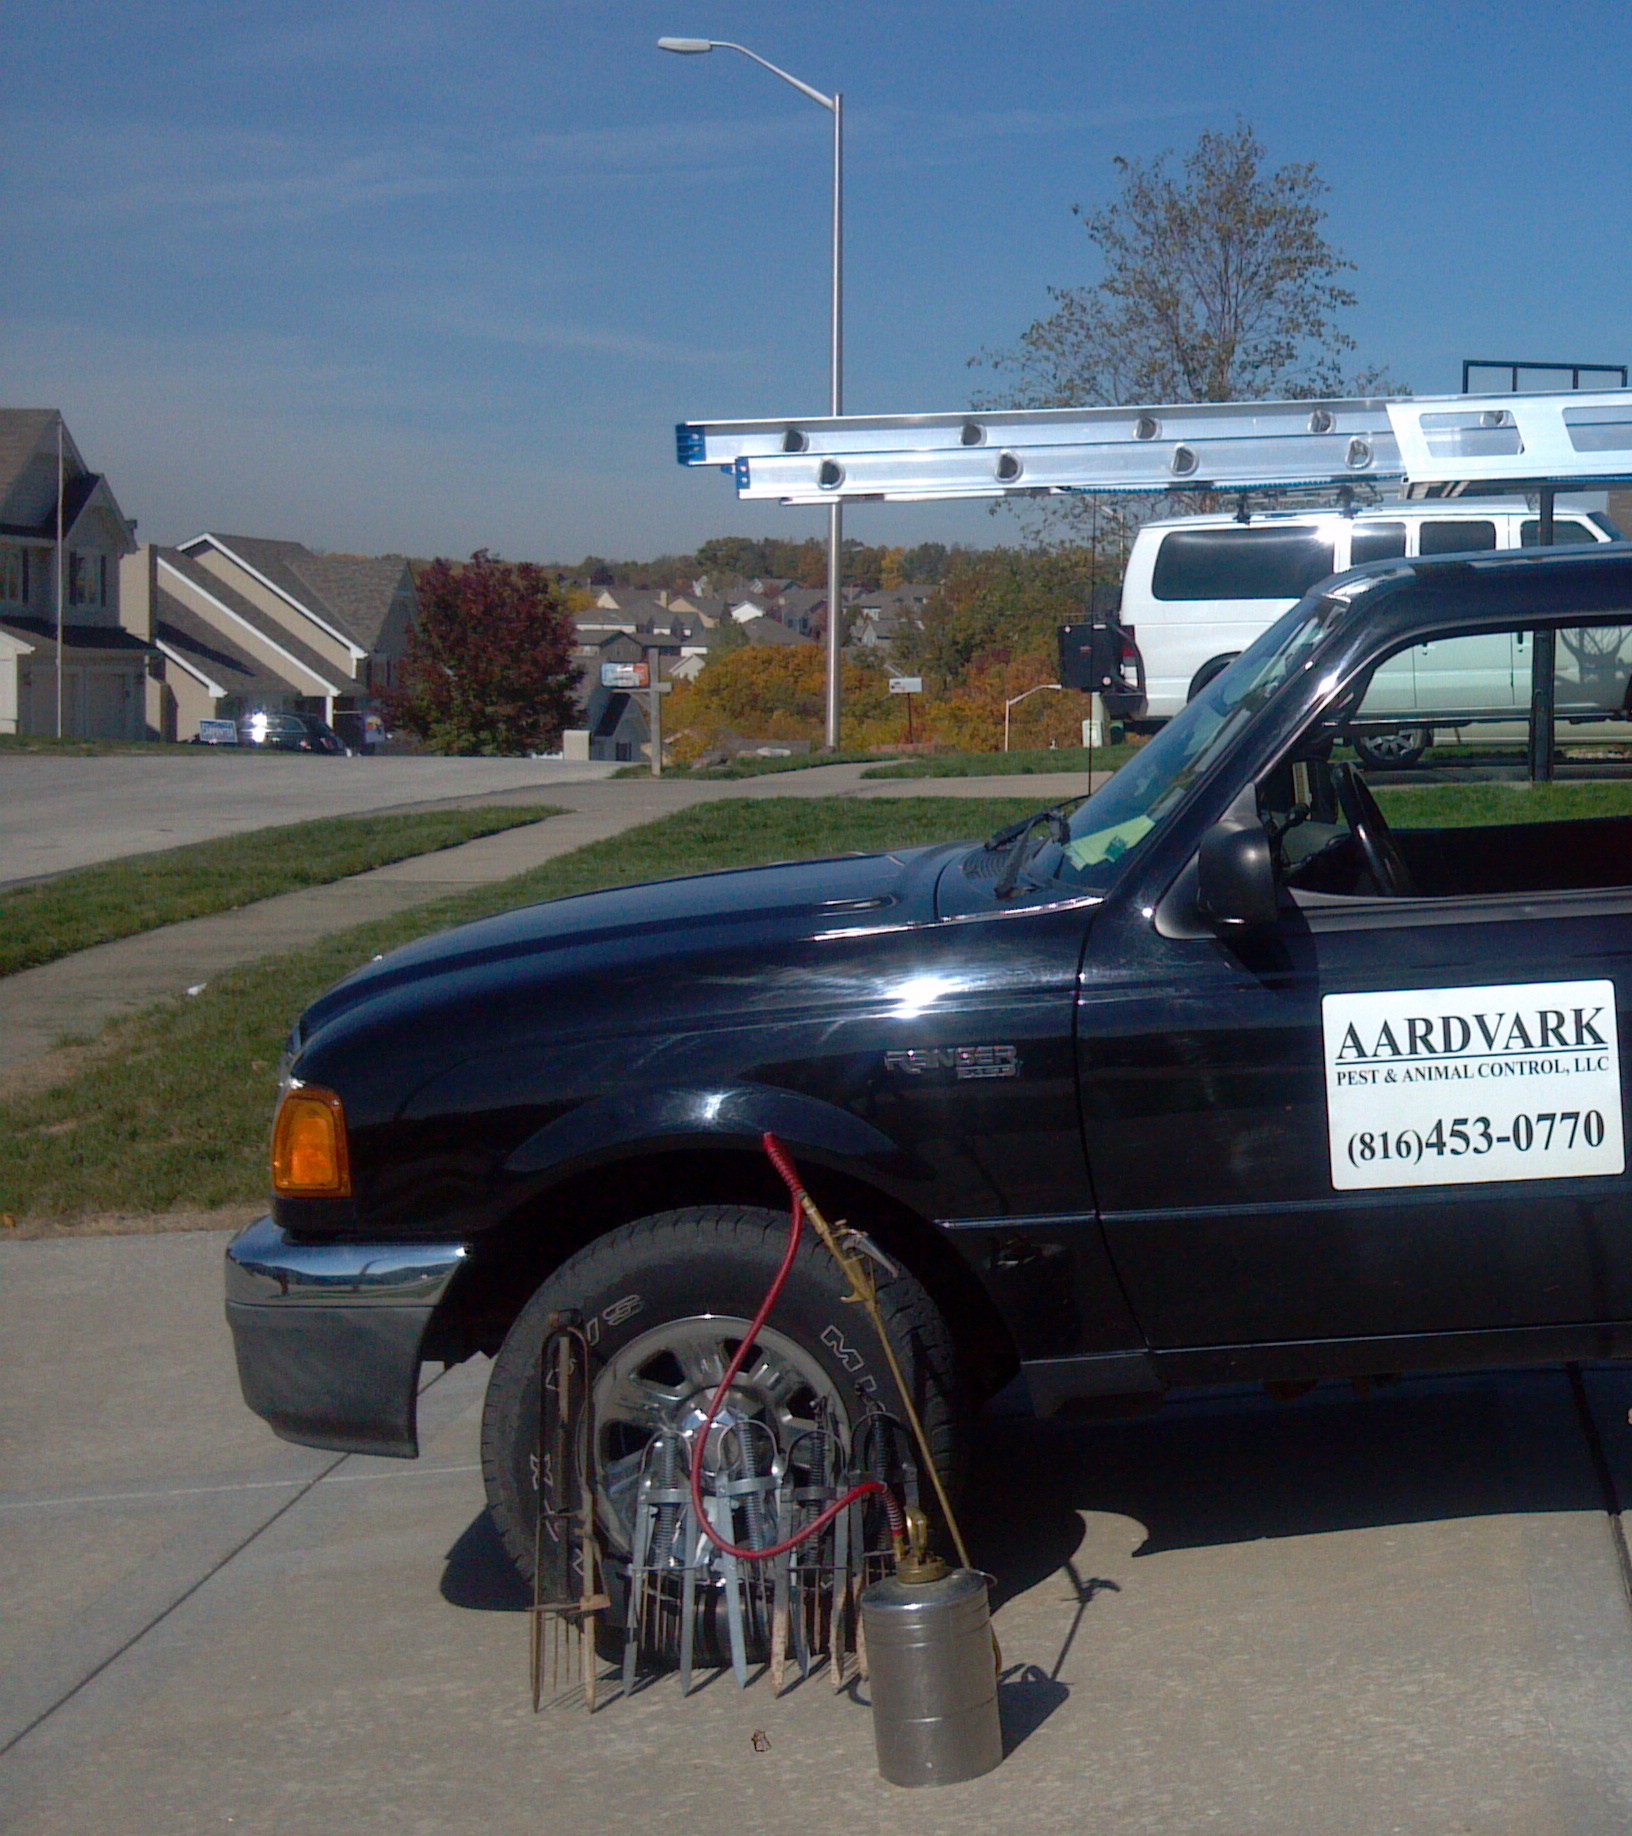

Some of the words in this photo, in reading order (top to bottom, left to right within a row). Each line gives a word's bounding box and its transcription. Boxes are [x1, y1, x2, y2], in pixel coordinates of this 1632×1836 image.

[1336, 1006, 1608, 1060] AARDVARK
[1336, 1070, 1380, 1087] PEST
[1384, 1069, 1398, 1083] &
[1401, 1064, 1475, 1083] ANIMAL
[1477, 1059, 1571, 1079] CONTROL,
[1574, 1055, 1610, 1073] LLC
[1347, 1109, 1605, 1168] (816)453-0770
